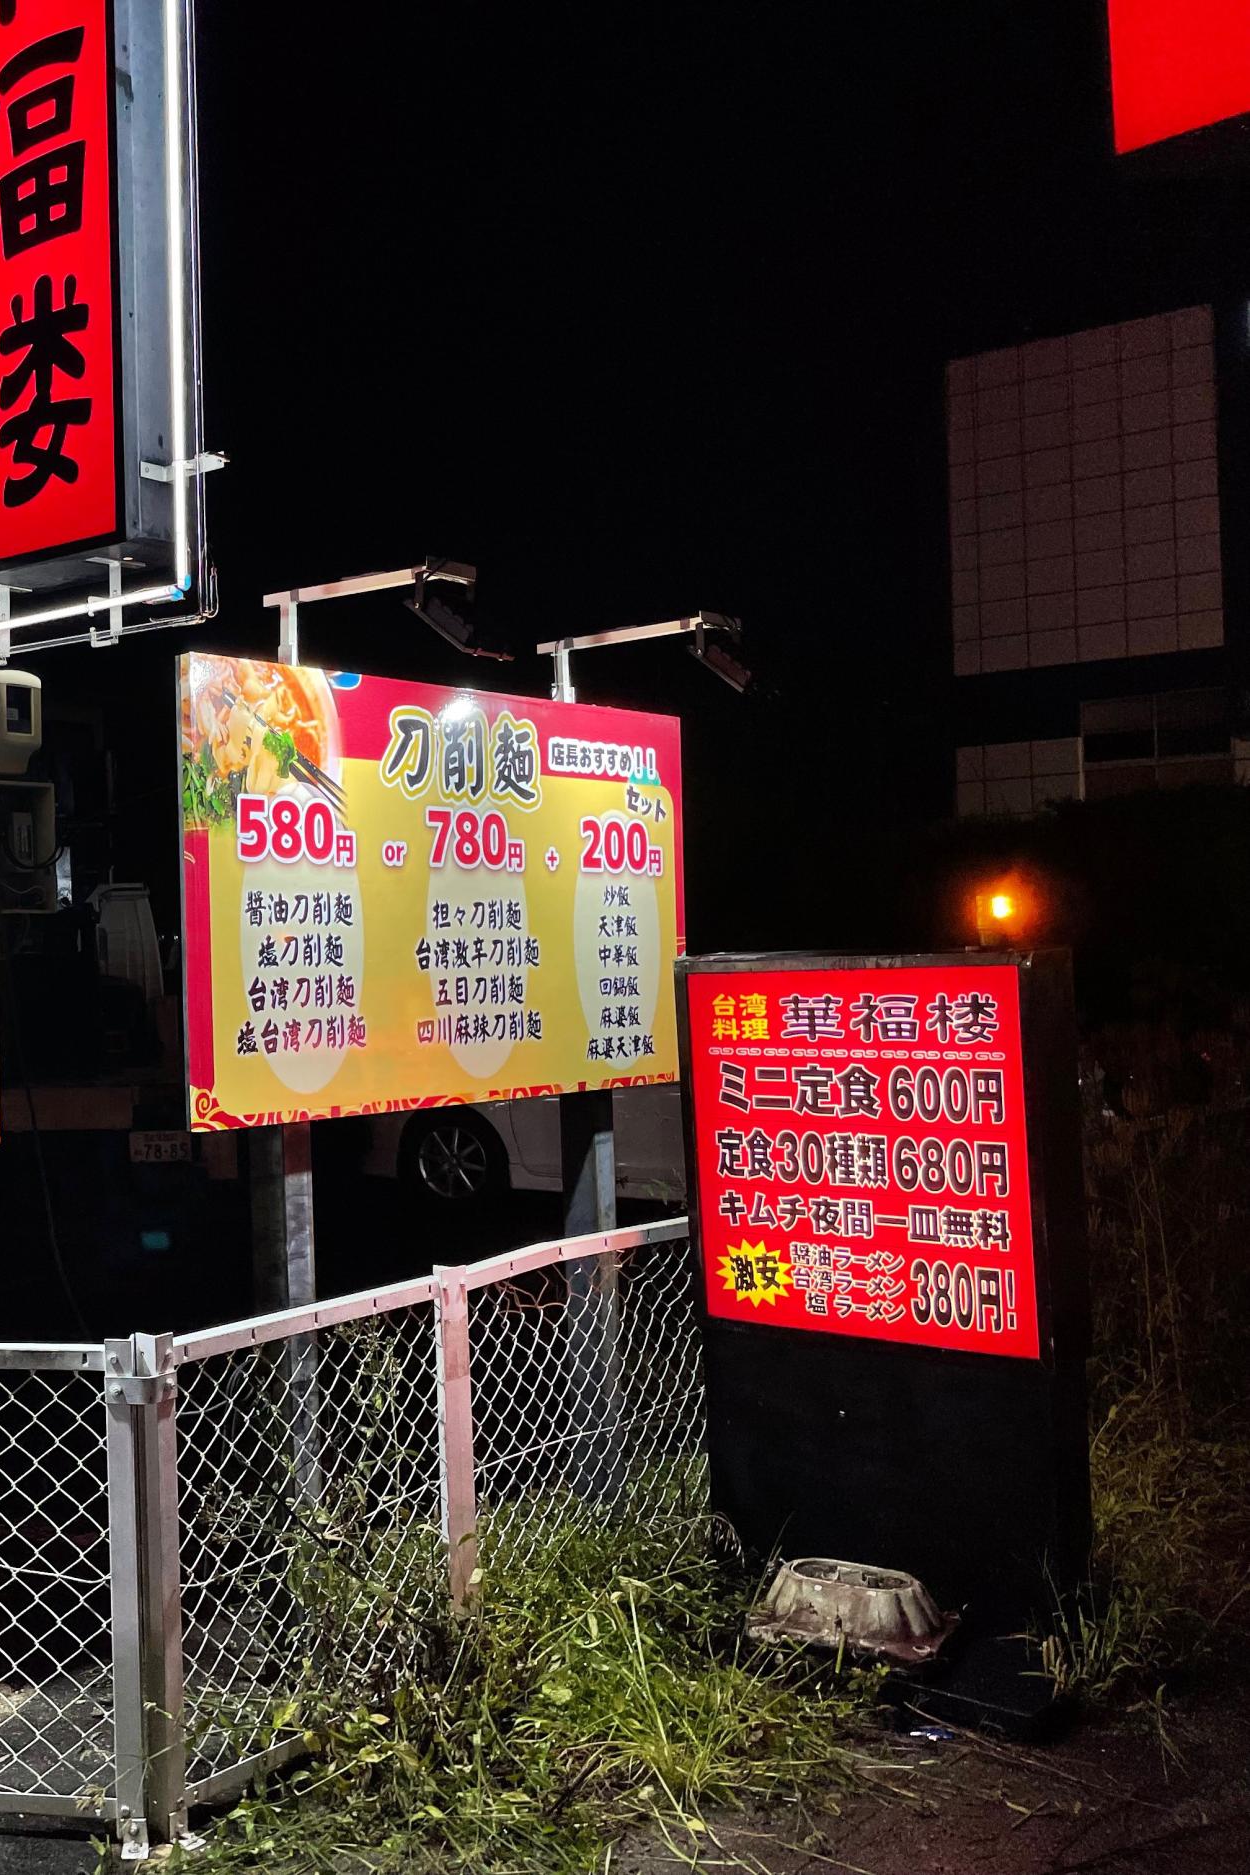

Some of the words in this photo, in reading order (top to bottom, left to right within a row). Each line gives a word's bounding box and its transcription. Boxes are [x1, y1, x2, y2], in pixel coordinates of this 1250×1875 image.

[626, 785, 667, 823] セット
[238, 799, 354, 863] 580円
[384, 845, 405, 866] or
[426, 810, 524, 869] 780円
[581, 819, 662, 873] 200円
[603, 885, 631, 908] 炒飯
[597, 914, 639, 938] 天津飯
[598, 944, 640, 969] 中華飯
[599, 975, 641, 997] 回鍋飯
[600, 1005, 642, 1030] 麻婆飯
[712, 993, 768, 1017] 台湾
[779, 992, 998, 1044] 華福楼
[712, 1017, 771, 1041] 料理
[586, 1034, 656, 1061] 麻婆天津飯
[718, 1061, 881, 1119] ミニ定食
[889, 1066, 1005, 1125] 600円
[715, 1128, 889, 1190] 定食30種類
[893, 1138, 1010, 1199] 680円
[718, 1191, 1011, 1252] キムチ夜間一皿無料
[729, 1254, 781, 1293] 激安
[791, 1266, 907, 1300] 台湾ラーメン
[911, 1260, 1017, 1334] 380円!
